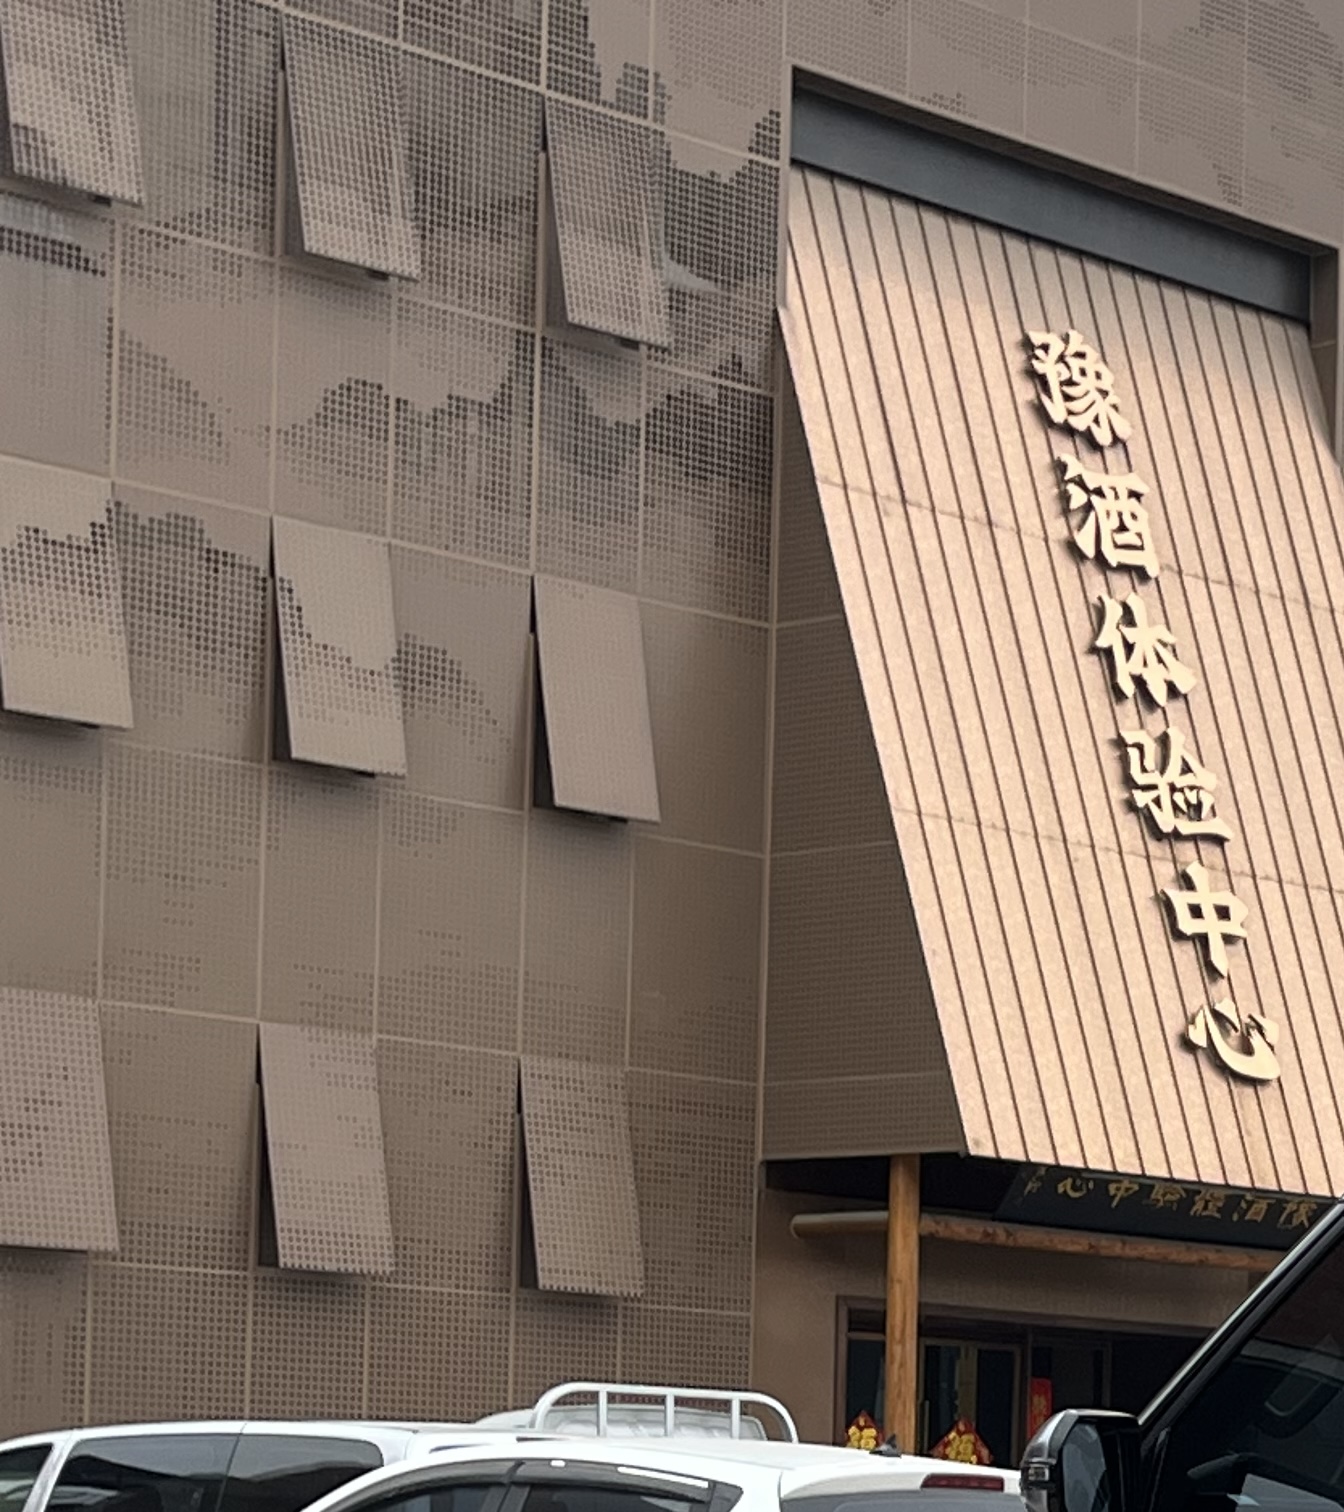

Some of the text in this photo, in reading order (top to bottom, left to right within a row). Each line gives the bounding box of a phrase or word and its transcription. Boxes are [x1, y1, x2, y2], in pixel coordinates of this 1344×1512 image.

[1026, 327, 1280, 1083] 豫酒体验中心
